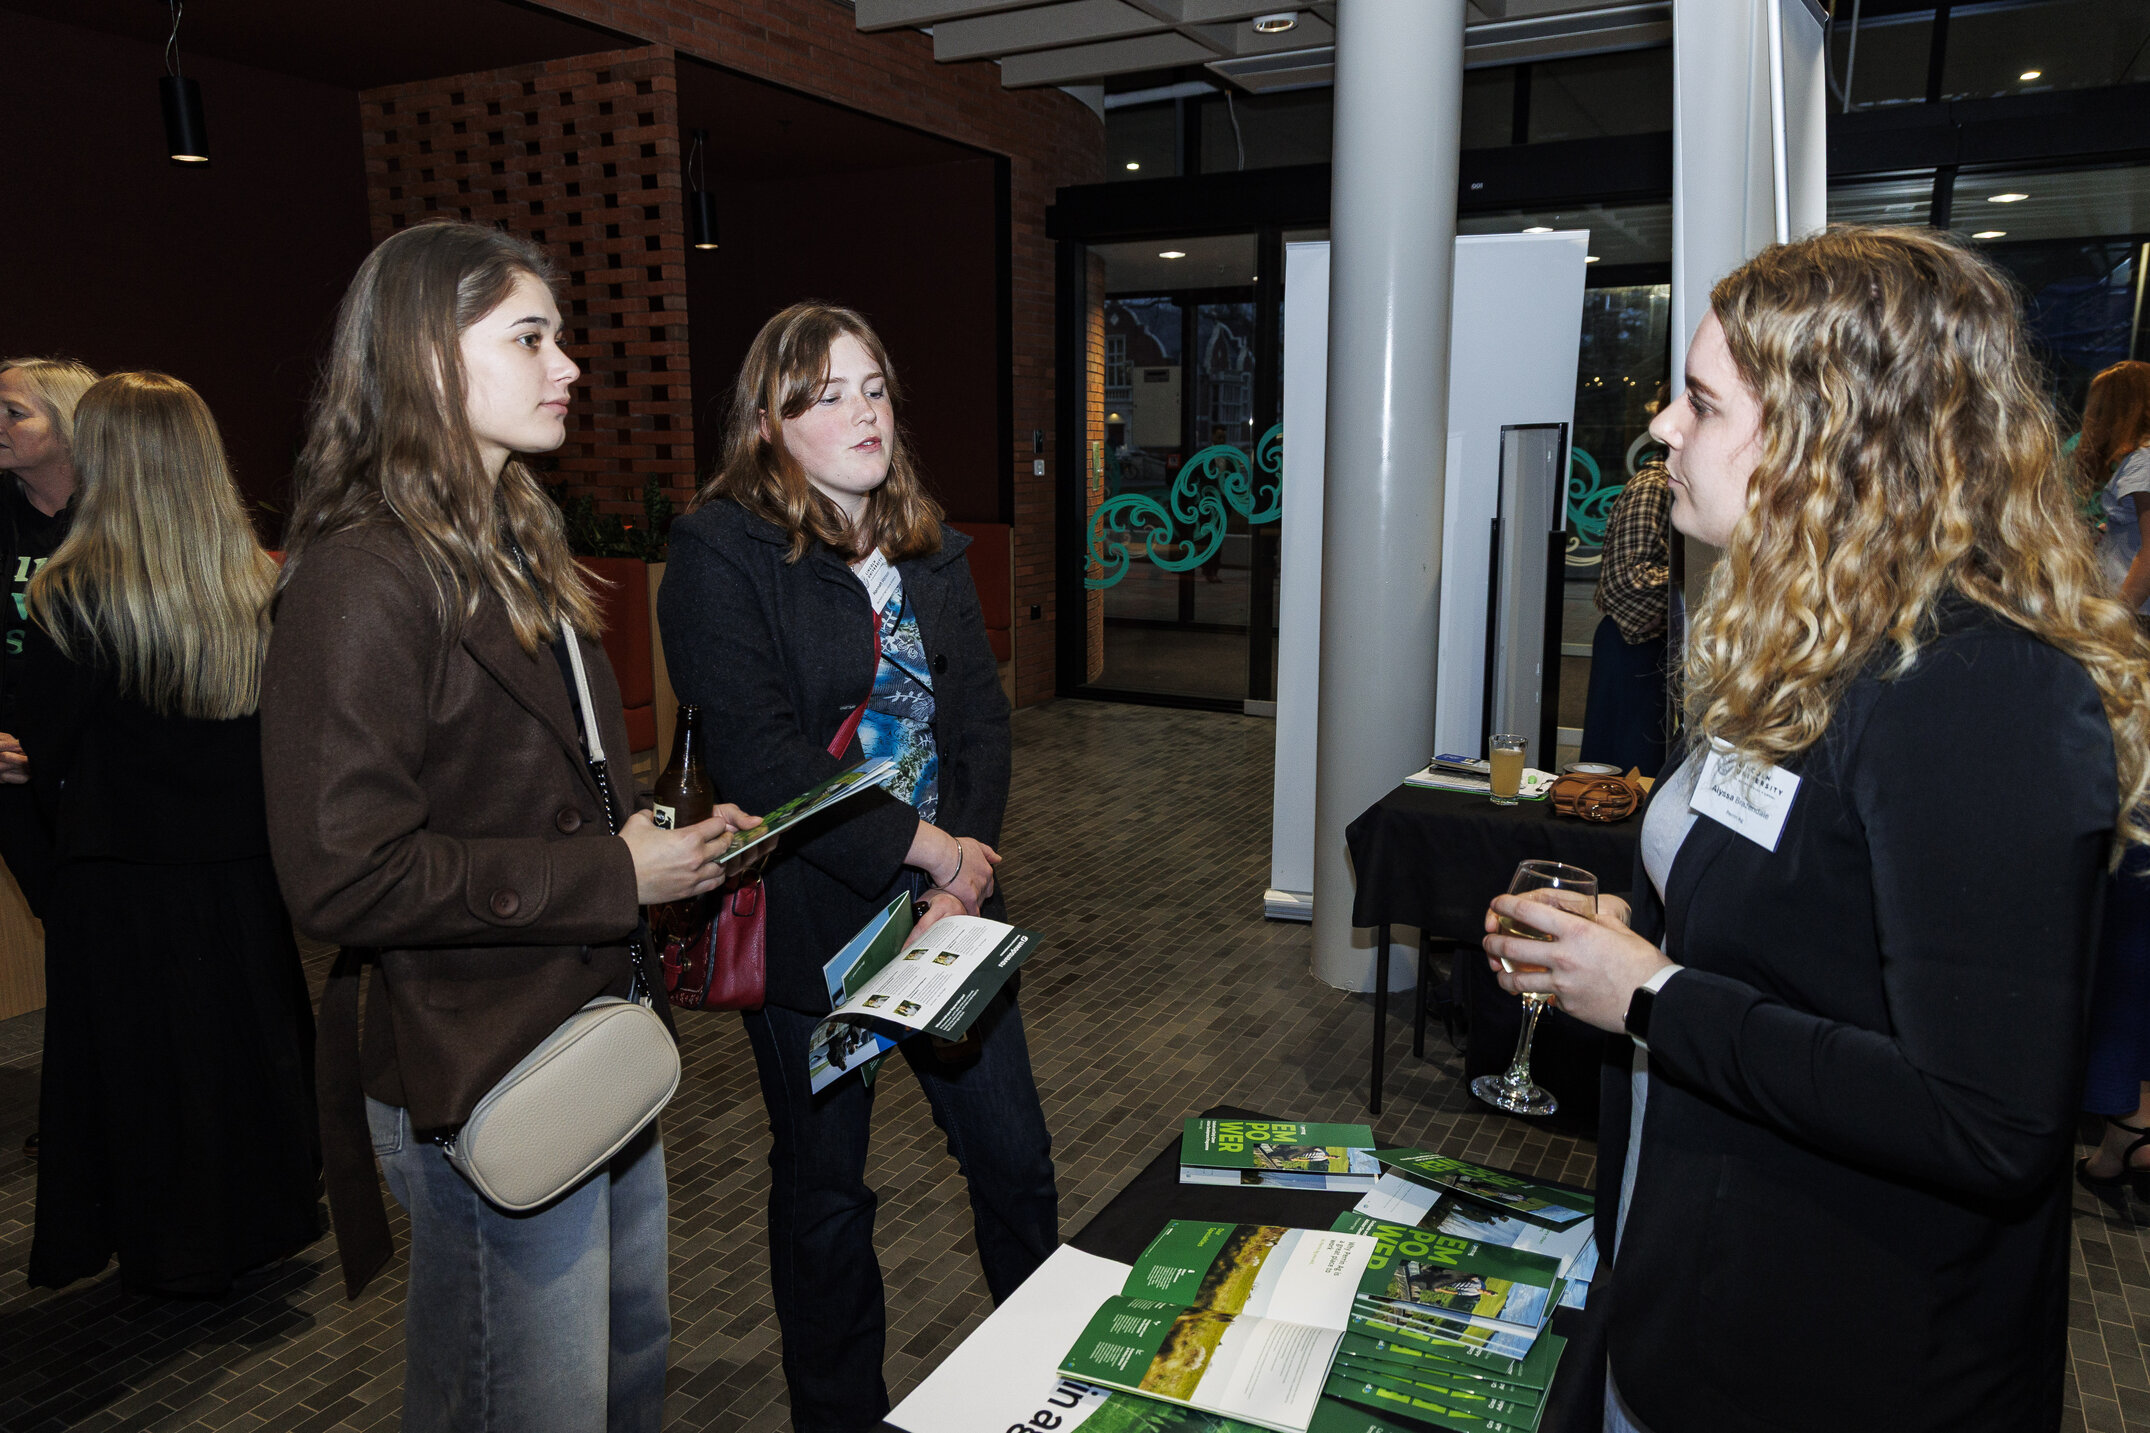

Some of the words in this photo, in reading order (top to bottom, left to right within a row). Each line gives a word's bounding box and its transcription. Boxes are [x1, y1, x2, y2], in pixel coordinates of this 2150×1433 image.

[1711, 784, 1735, 802] Alyssa
[1218, 1121, 1244, 1153] WER
[1244, 1122, 1271, 1141] PO
[1271, 1123, 1298, 1143] EM
[1398, 1229, 1438, 1257] PO
[1427, 1235, 1469, 1266] EM
[1047, 1380, 1098, 1408] in
